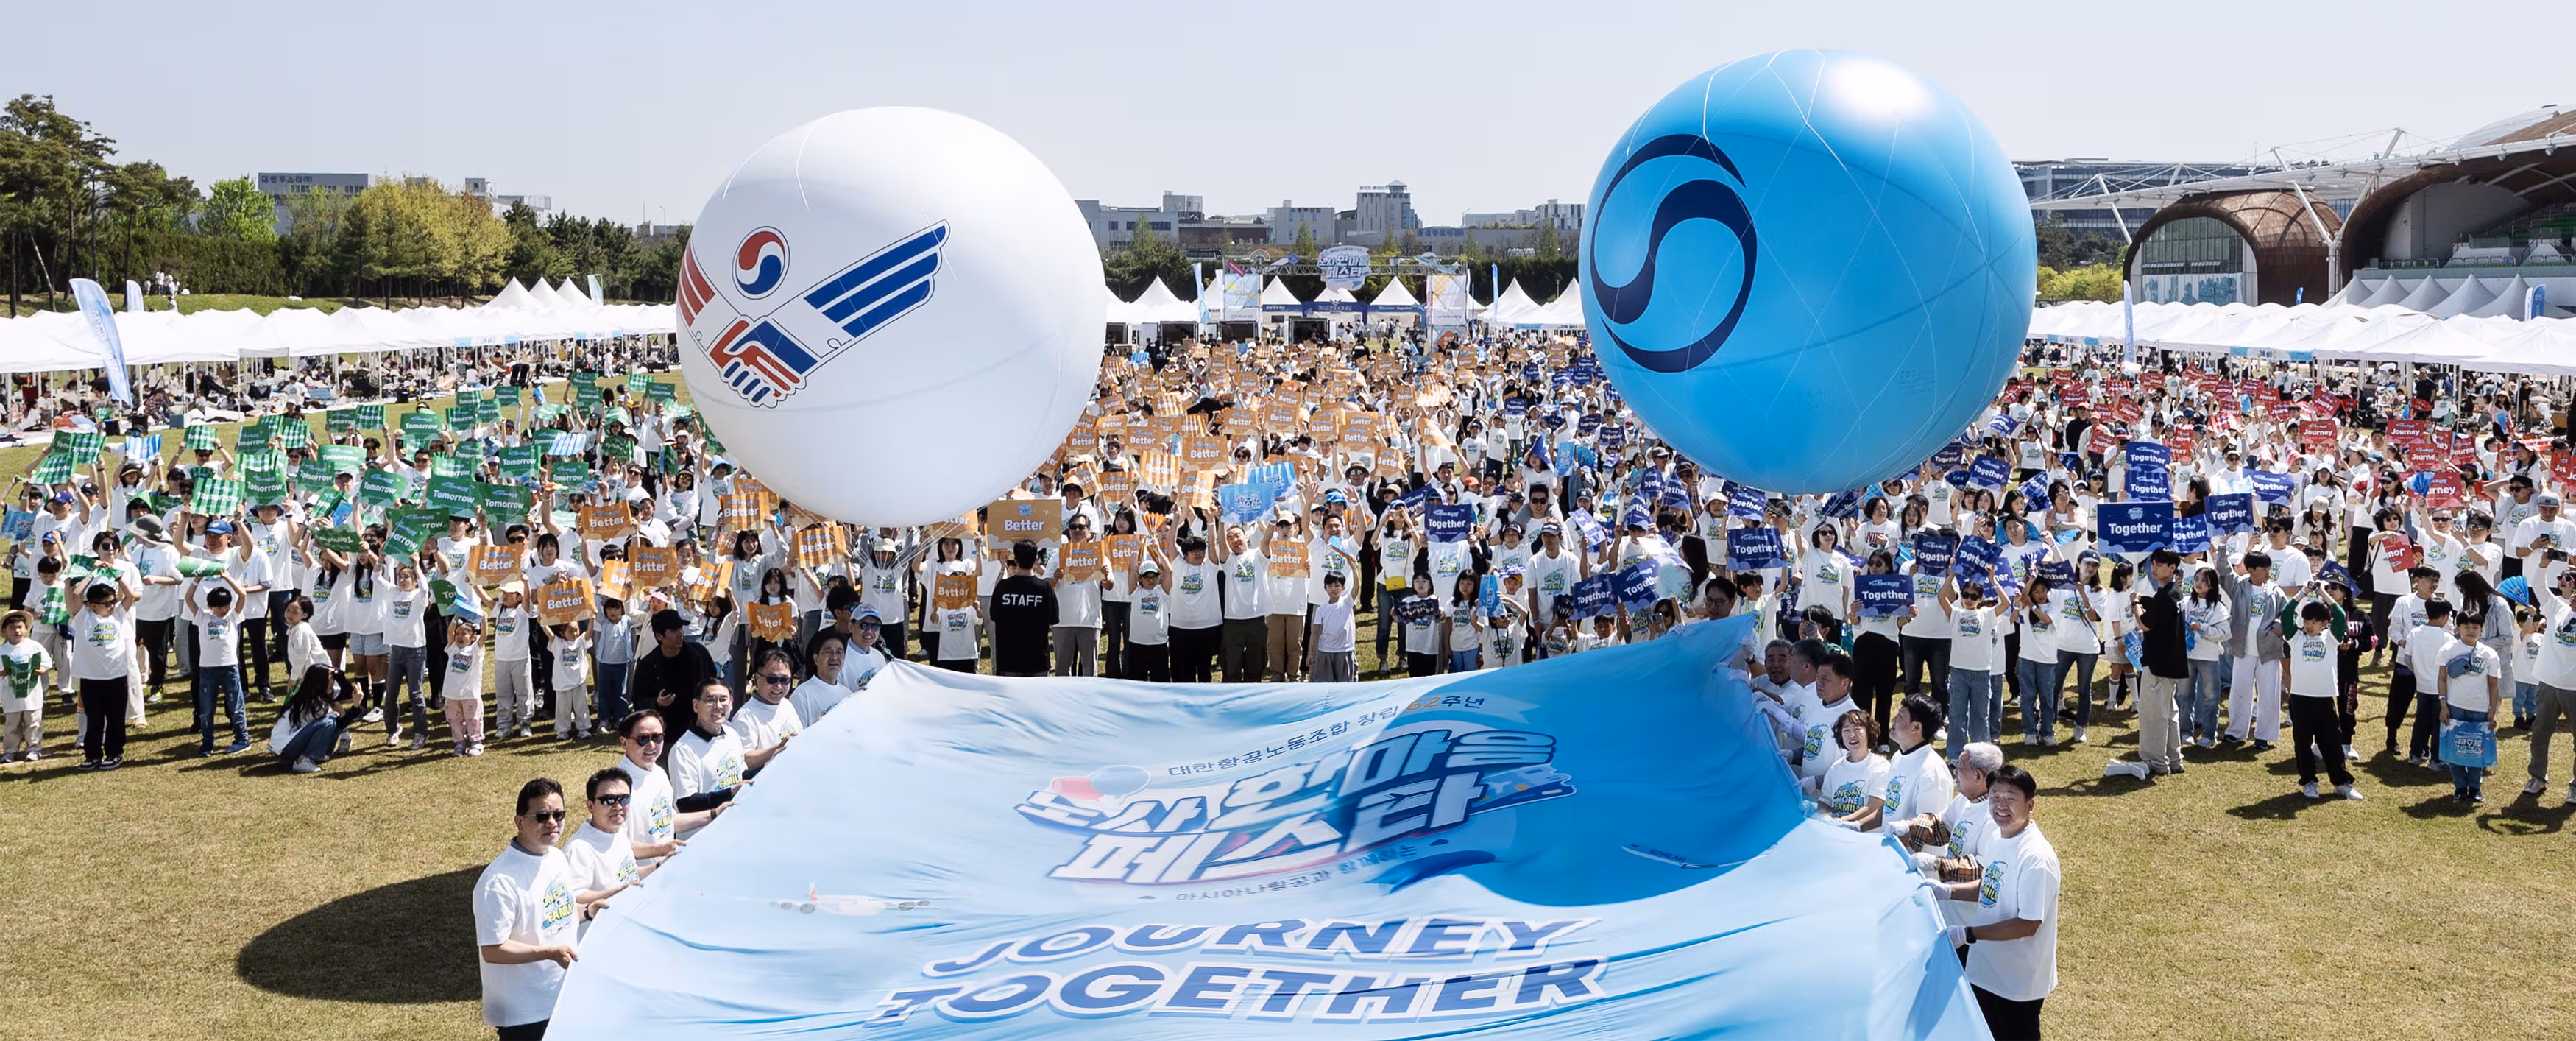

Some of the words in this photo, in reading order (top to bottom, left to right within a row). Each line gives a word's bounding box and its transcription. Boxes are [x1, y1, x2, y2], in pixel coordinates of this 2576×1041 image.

[1326, 266, 1362, 278] 페스타
[1278, 395, 1298, 404] Better
[2315, 398, 2333, 411] Journey
[1190, 449, 1220, 459] Better
[2130, 454, 2165, 465] Together
[1145, 465, 1175, 474] Better
[1974, 465, 2003, 479] Together
[300, 470, 332, 481] Tomorrow
[247, 482, 283, 492] Tomorrow
[364, 483, 397, 495] Tomorrow
[1181, 484, 1209, 494] Better
[2130, 484, 2167, 495] Together
[2427, 485, 2455, 495] urney
[197, 492, 240, 502] Tomorrow
[433, 490, 475, 503] Tomorrow
[485, 499, 524, 509] Tomorrow
[724, 507, 759, 518] Better
[2212, 509, 2246, 520] Together
[590, 515, 624, 527] Better
[1005, 520, 1044, 532] Better
[1428, 518, 1466, 529] Together
[2108, 522, 2162, 536] Together
[800, 541, 835, 553] Better
[1735, 543, 1777, 555] Together
[1066, 556, 1097, 567] Better
[1272, 554, 1302, 564] Better
[479, 560, 514, 571] Better
[634, 562, 667, 571] Better
[938, 587, 969, 597] Better
[1578, 590, 1611, 605] Together
[1861, 590, 1908, 601] Together
[547, 595, 584, 610] Better
[1002, 594, 1043, 607] STAFF
[1168, 719, 1350, 777] 대한항공노동조합
[1358, 705, 1399, 727] 창립
[1406, 695, 1485, 712] 62주년
[1842, 797, 1858, 805] ONE
[1047, 773, 1488, 883] 페스타
[1649, 849, 1686, 861] KOREAN
[1175, 869, 1332, 901] 아시아나항공과
[1338, 844, 1418, 875] 함께하는
[922, 917, 1602, 978] JOURNEY
[867, 956, 1608, 1024] TOGETHER
